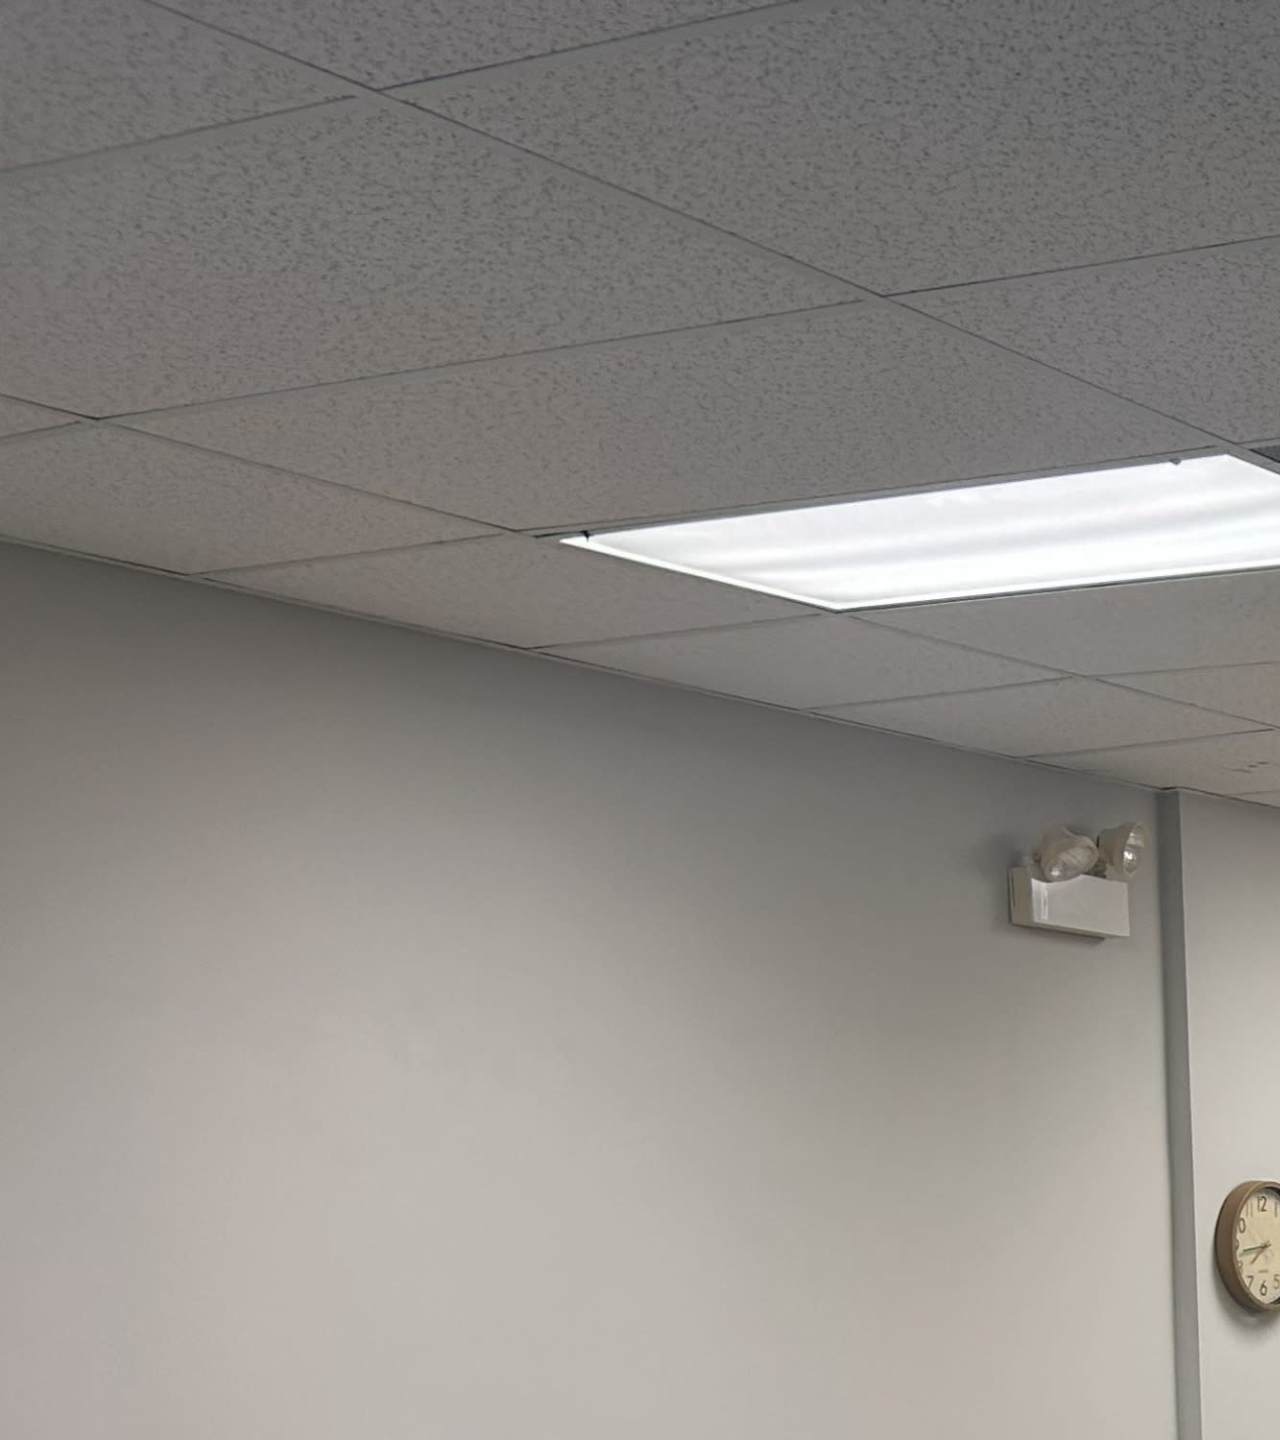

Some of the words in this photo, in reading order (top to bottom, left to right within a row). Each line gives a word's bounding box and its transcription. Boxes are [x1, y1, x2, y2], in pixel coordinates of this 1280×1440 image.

[1256, 1195, 1267, 1213] 12
[1259, 1280, 1267, 1296] 6
[1273, 1274, 1280, 1290] 5
